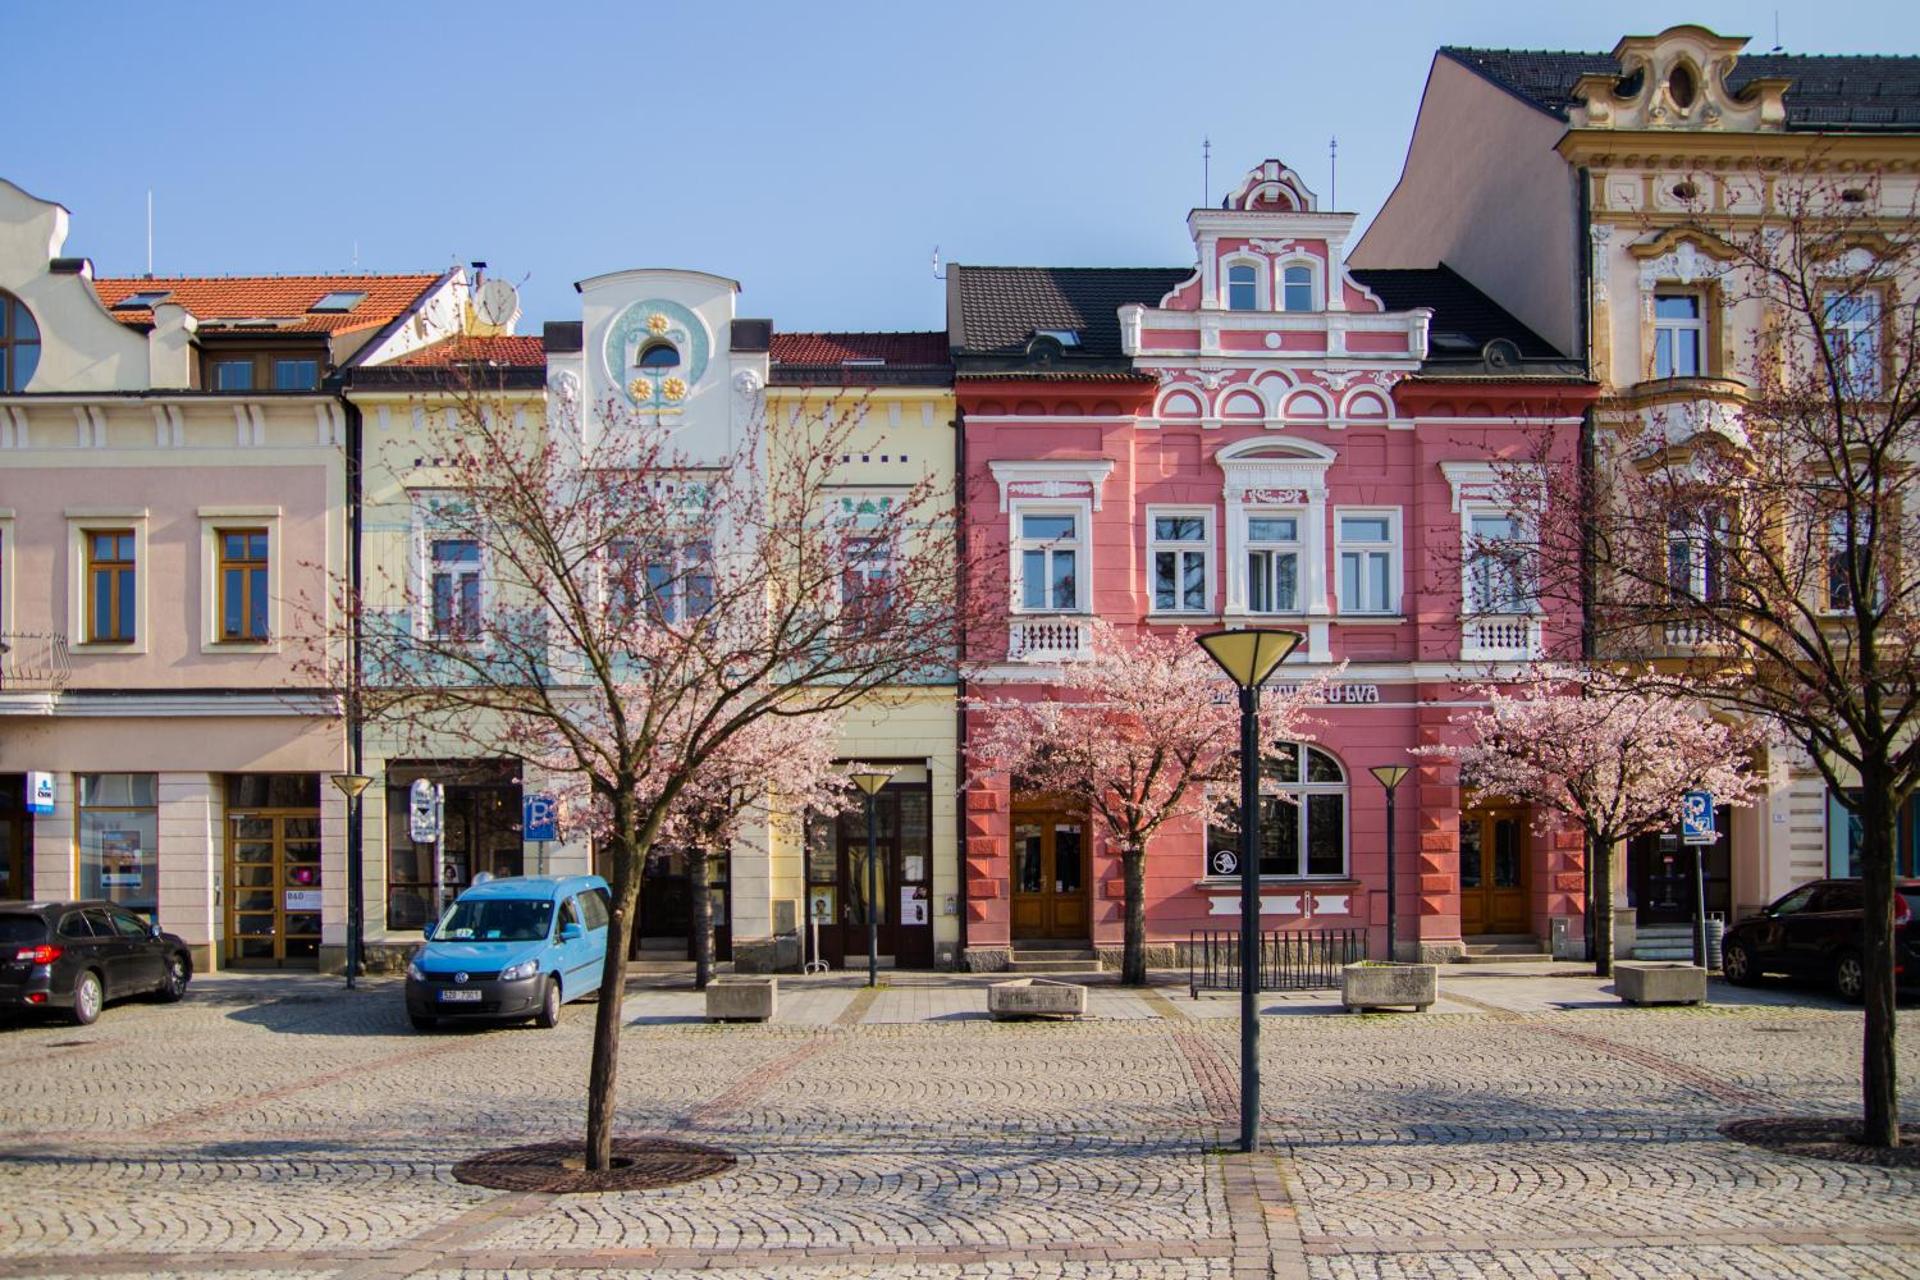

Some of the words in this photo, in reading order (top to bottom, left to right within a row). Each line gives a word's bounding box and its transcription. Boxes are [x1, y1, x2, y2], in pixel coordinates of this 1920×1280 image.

[1329, 685, 1341, 702] U
[1345, 684, 1380, 703] LVA
[532, 802, 548, 823] P
